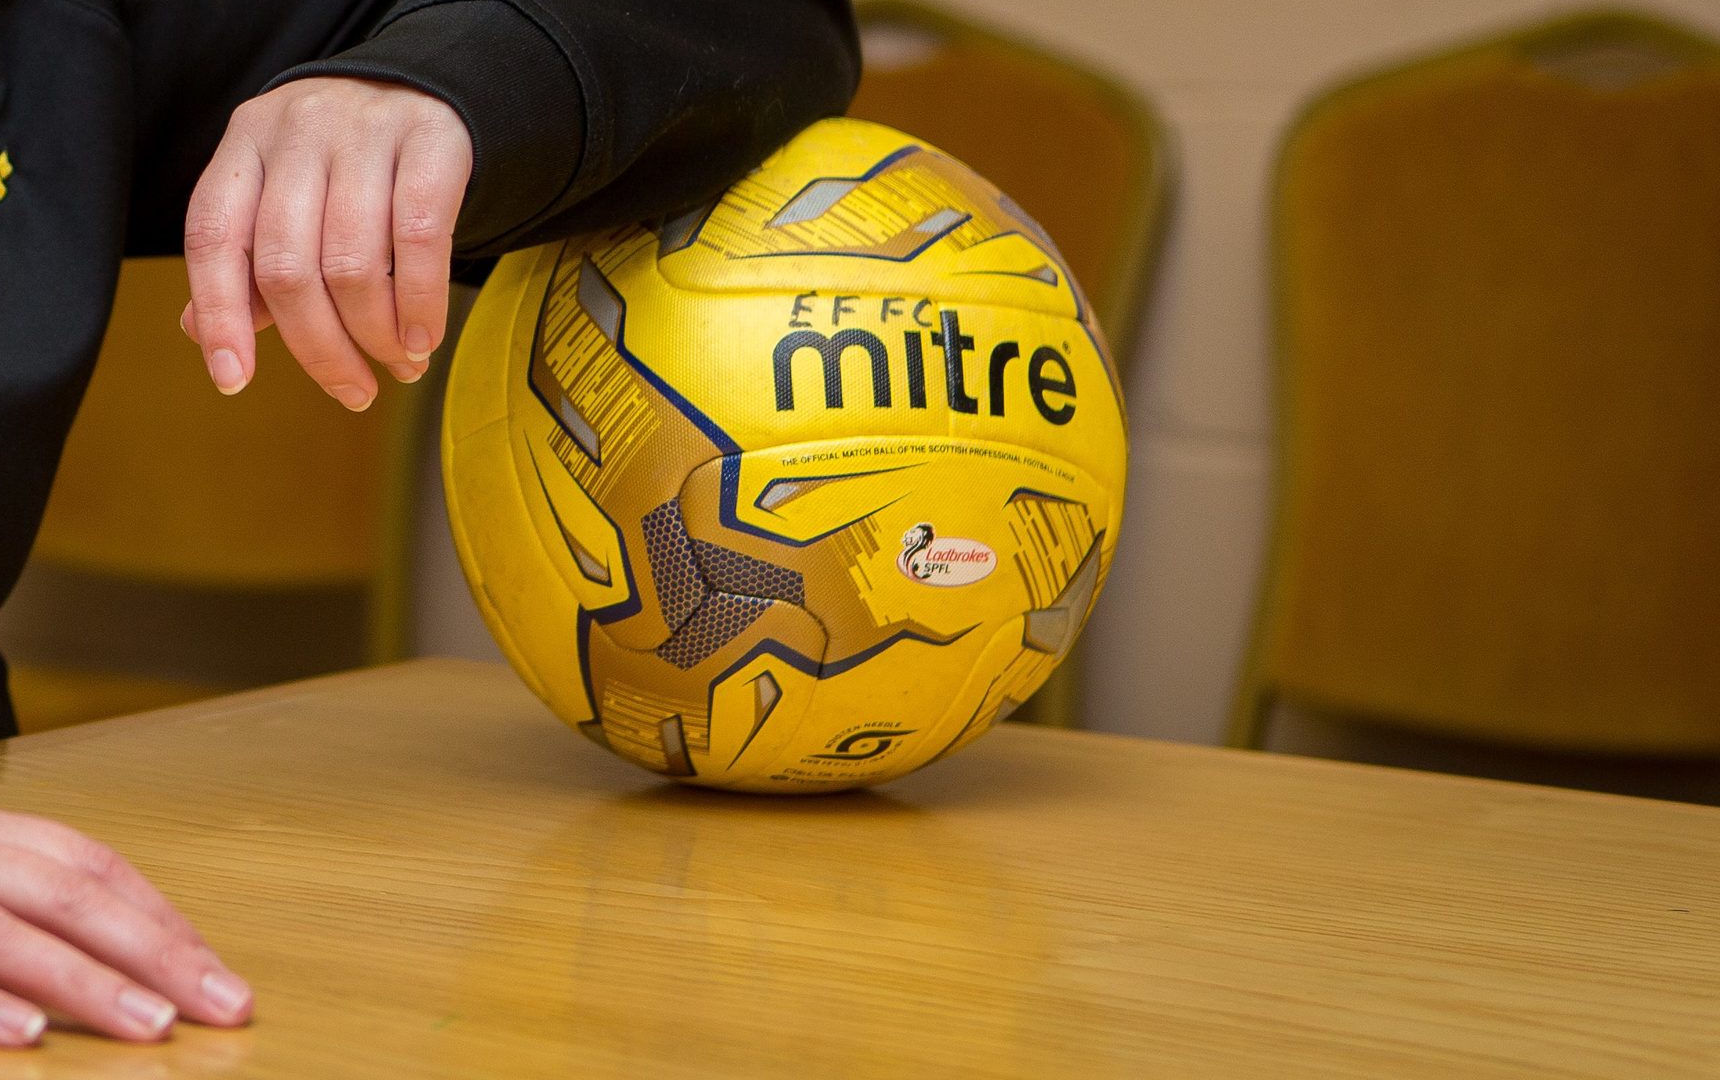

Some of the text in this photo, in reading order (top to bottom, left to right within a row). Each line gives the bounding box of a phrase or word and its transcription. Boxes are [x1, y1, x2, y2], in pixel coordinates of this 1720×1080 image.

[772, 309, 1078, 426] mitre
[782, 458, 799, 467] THE
[800, 453, 840, 464] OFFICIAL
[842, 448, 872, 458] MATCH
[873, 446, 895, 455] BALL
[897, 445, 908, 454] OF
[910, 445, 926, 453] THE
[928, 445, 968, 454] SCOTTISH
[969, 447, 1022, 464] PROFESSIONAL
[1023, 457, 1054, 474] FOOTBALL
[925, 548, 990, 562] Ladbrokes
[923, 563, 952, 574] SPFL
